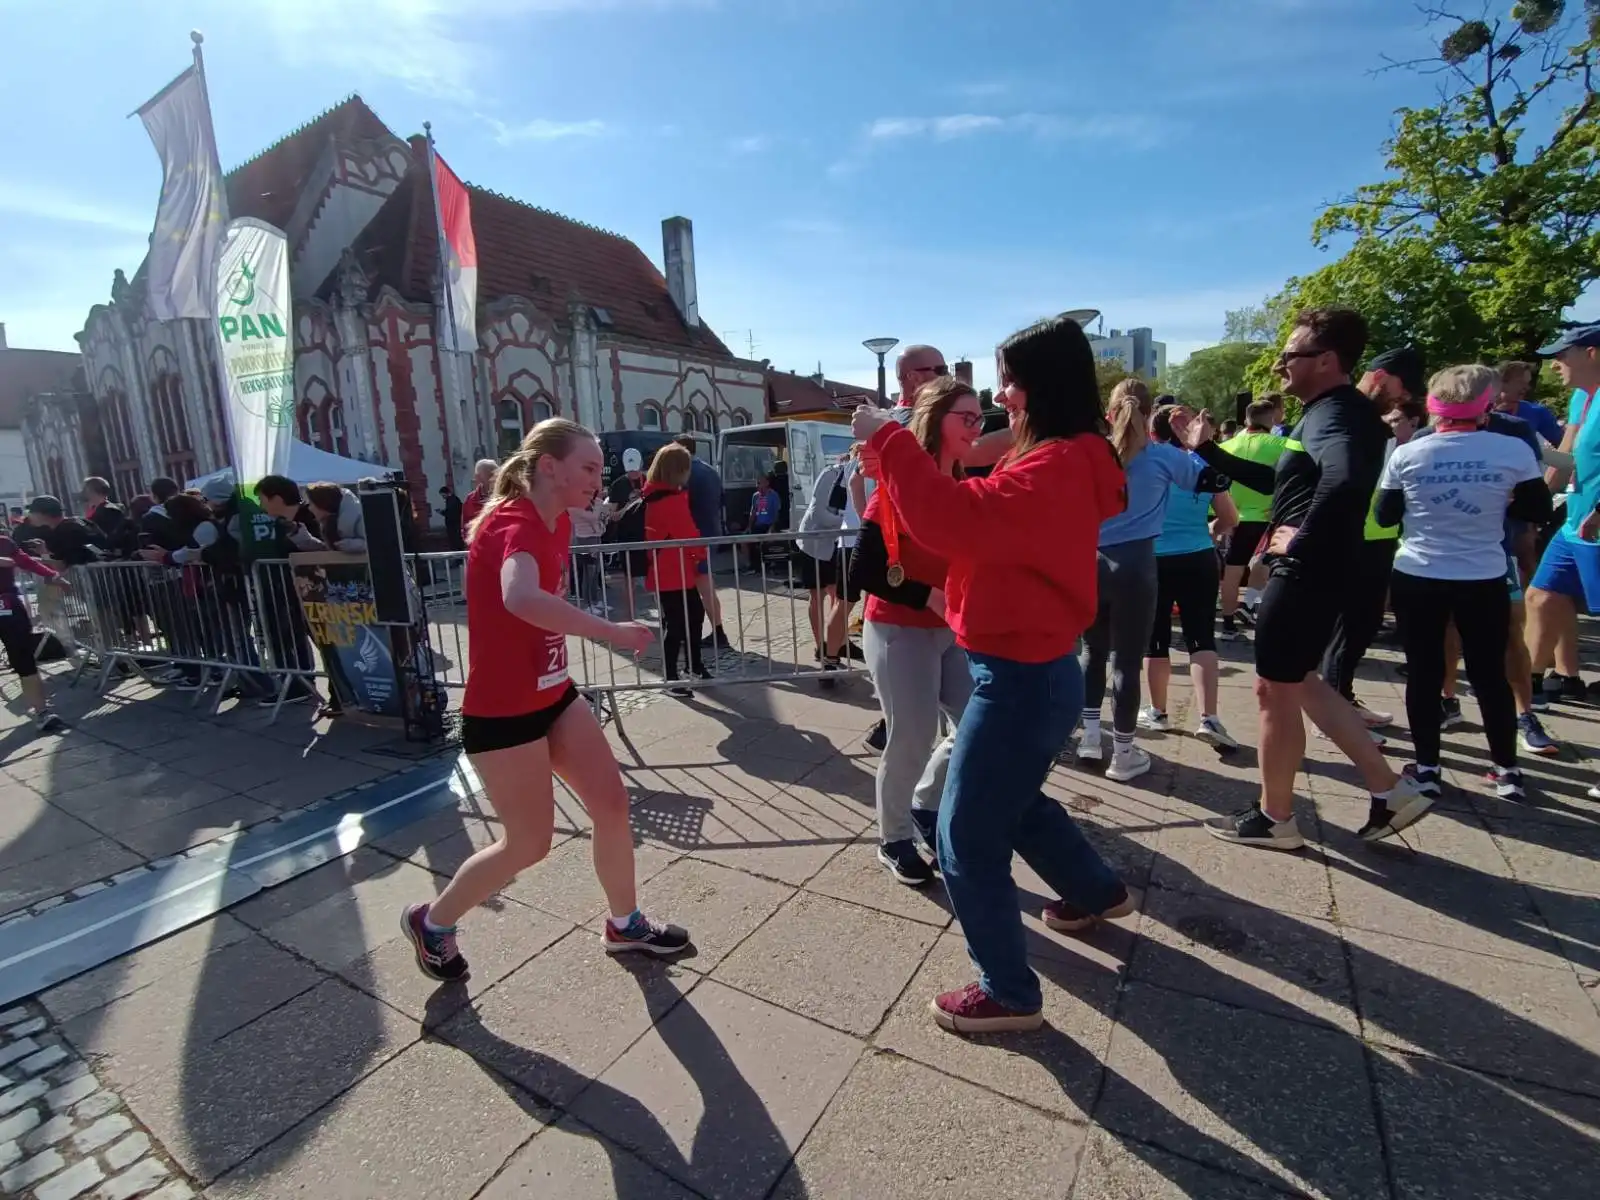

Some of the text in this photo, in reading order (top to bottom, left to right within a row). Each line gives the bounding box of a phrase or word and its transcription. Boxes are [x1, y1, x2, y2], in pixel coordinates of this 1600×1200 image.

[220, 313, 286, 342] PAN
[1433, 460, 1487, 470] PTICE
[1430, 488, 1459, 505] BIP
[1453, 499, 1481, 515] BIP
